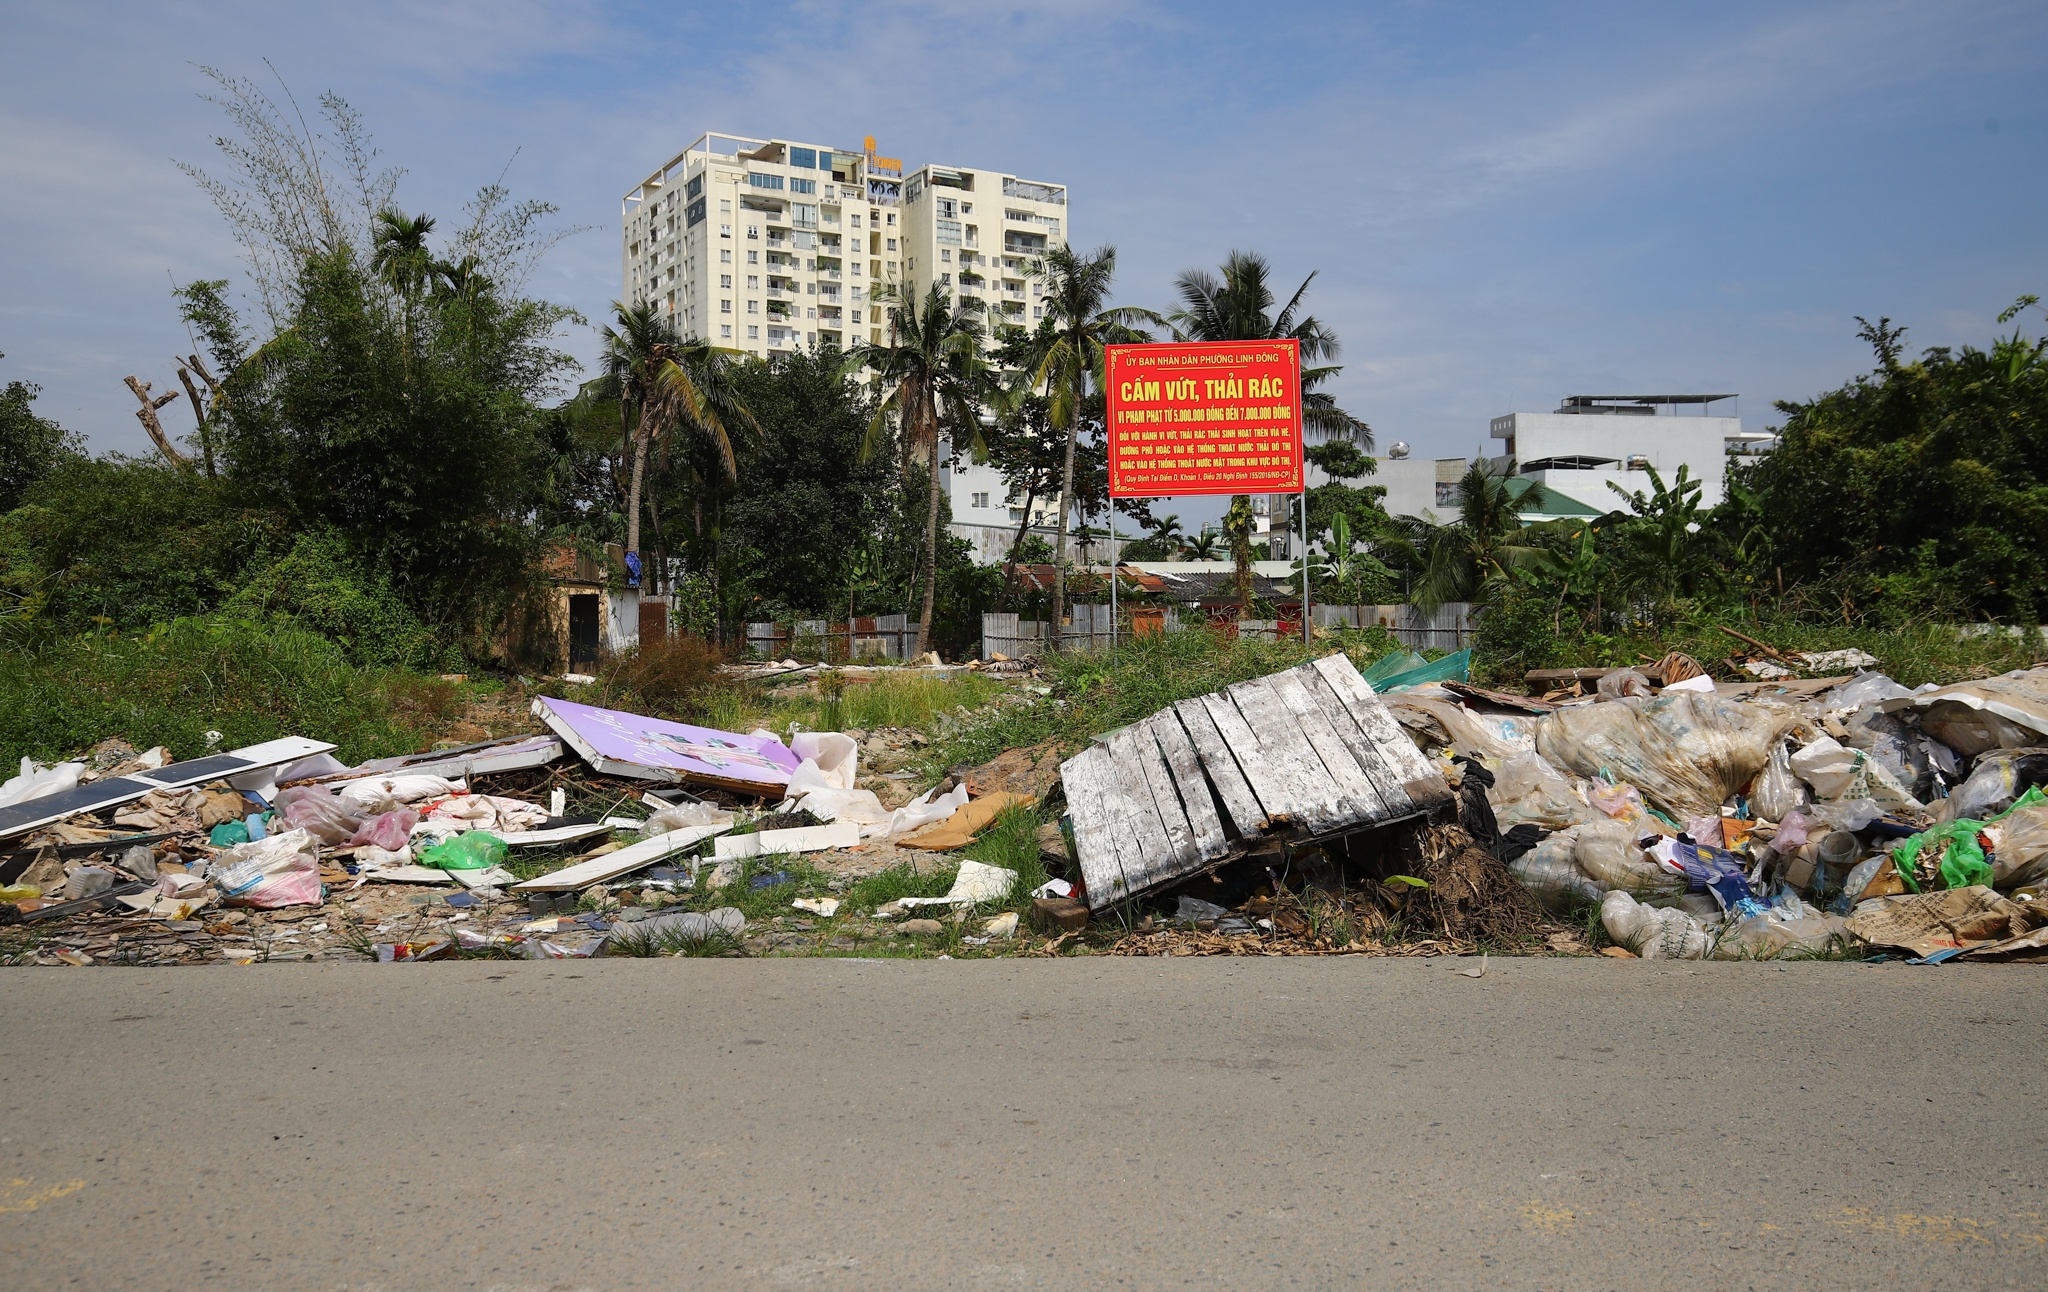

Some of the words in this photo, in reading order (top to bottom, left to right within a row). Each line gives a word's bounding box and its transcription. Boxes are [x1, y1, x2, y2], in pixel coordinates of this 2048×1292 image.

[872, 156, 903, 171] TOWER
[1126, 355, 1136, 366] ỦY
[1139, 357, 1155, 366] BAN
[1157, 355, 1180, 365] NHÂN
[1182, 354, 1198, 364] DÂN
[1200, 353, 1233, 364] PHƯỜNG
[1236, 354, 1254, 363] LINH
[1256, 352, 1278, 362] ĐÔNG
[1121, 375, 1160, 402] CẤM
[1165, 377, 1200, 402] VỨT,
[1205, 372, 1242, 399] THẢI
[1249, 374, 1283, 398] RÁC
[1118, 411, 1124, 424] VI
[1126, 410, 1144, 426] PHẠM
[1146, 410, 1163, 425] PHẠT
[1164, 407, 1172, 425] TỪ
[1174, 409, 1204, 422] 5.000.000
[1206, 404, 1224, 421] ĐỒNG
[1226, 403, 1238, 420] ĐẾN
[1240, 407, 1271, 420] 7.000.000
[1273, 402, 1291, 419] ĐỒNG
[1142, 430, 1157, 440] HÀNH
[1159, 432, 1165, 440] VI
[1180, 428, 1192, 439] THẢI
[1194, 429, 1206, 439] RÁC
[1208, 427, 1220, 438] THẢI
[1222, 429, 1236, 438] SINH
[1238, 429, 1252, 439] HOẠT
[1254, 427, 1268, 437] TRÊN
[1141, 443, 1153, 454] PHỐ
[1173, 444, 1184, 453] VÀO
[1197, 442, 1215, 453] THỐNG
[1218, 442, 1235, 452] THOÁT
[1257, 440, 1269, 451] THẢI
[1272, 441, 1279, 451] ĐÔ
[1137, 459, 1148, 469] VÀO
[1158, 457, 1176, 468] THỐNG
[1178, 458, 1195, 468] THOÁT
[1227, 458, 1245, 467] TRONG
[1246, 457, 1258, 466] KHU
[1272, 455, 1279, 465] ĐÔ
